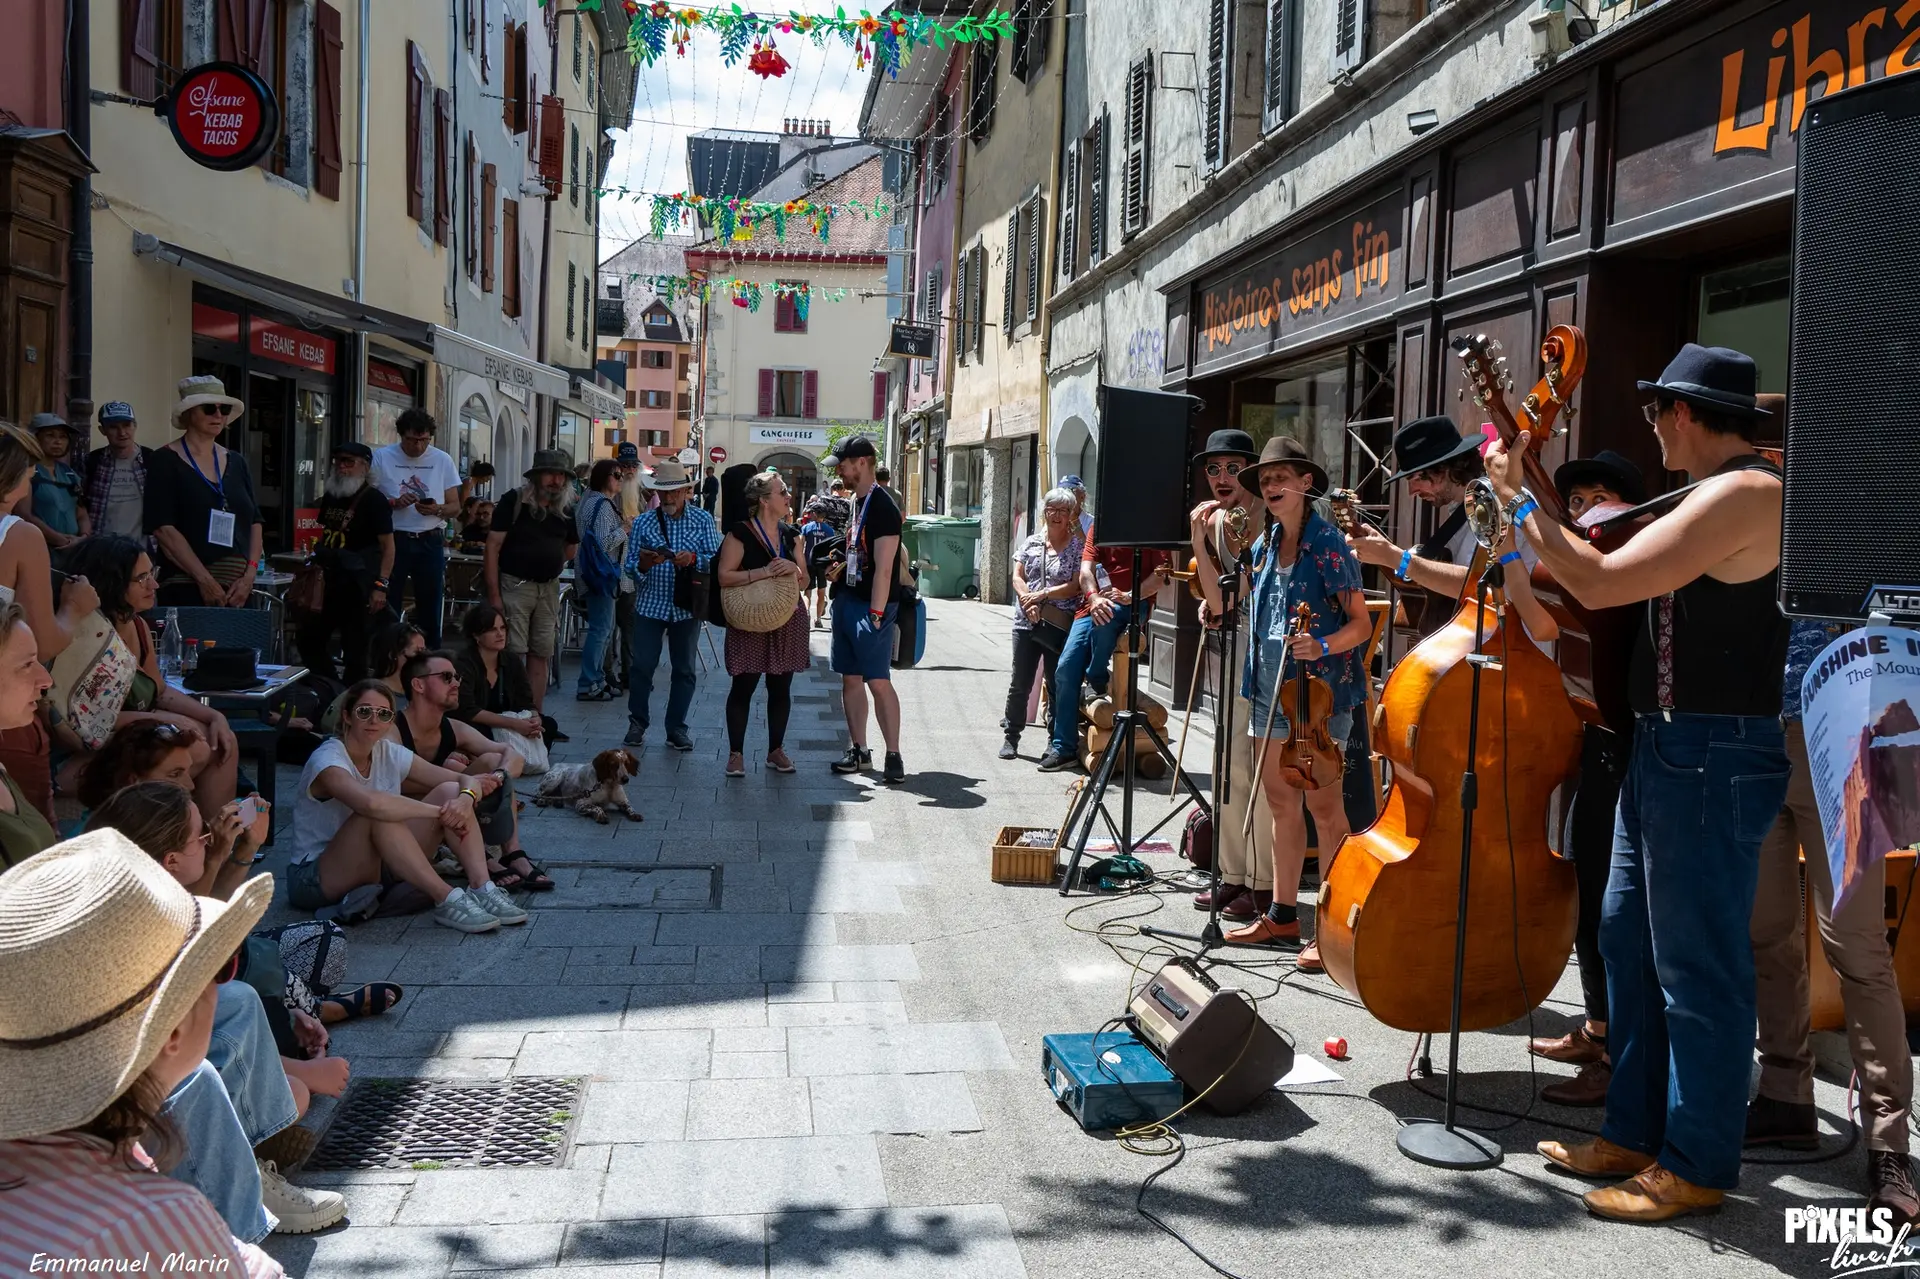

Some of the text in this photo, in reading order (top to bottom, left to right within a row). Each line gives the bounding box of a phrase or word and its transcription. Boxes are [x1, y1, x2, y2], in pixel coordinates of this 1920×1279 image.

[204, 113, 244, 128] KEBAB
[203, 130, 239, 145] TACOS
[1204, 221, 1390, 353] Histoires sans fin
[262, 331, 325, 364] EFSANE KEBAB
[484, 356, 534, 388] EFSANE KEBAB
[760, 429, 782, 438] GANG
[1803, 635, 1920, 714] SUNSHINE I
[1845, 667, 1873, 685] The
